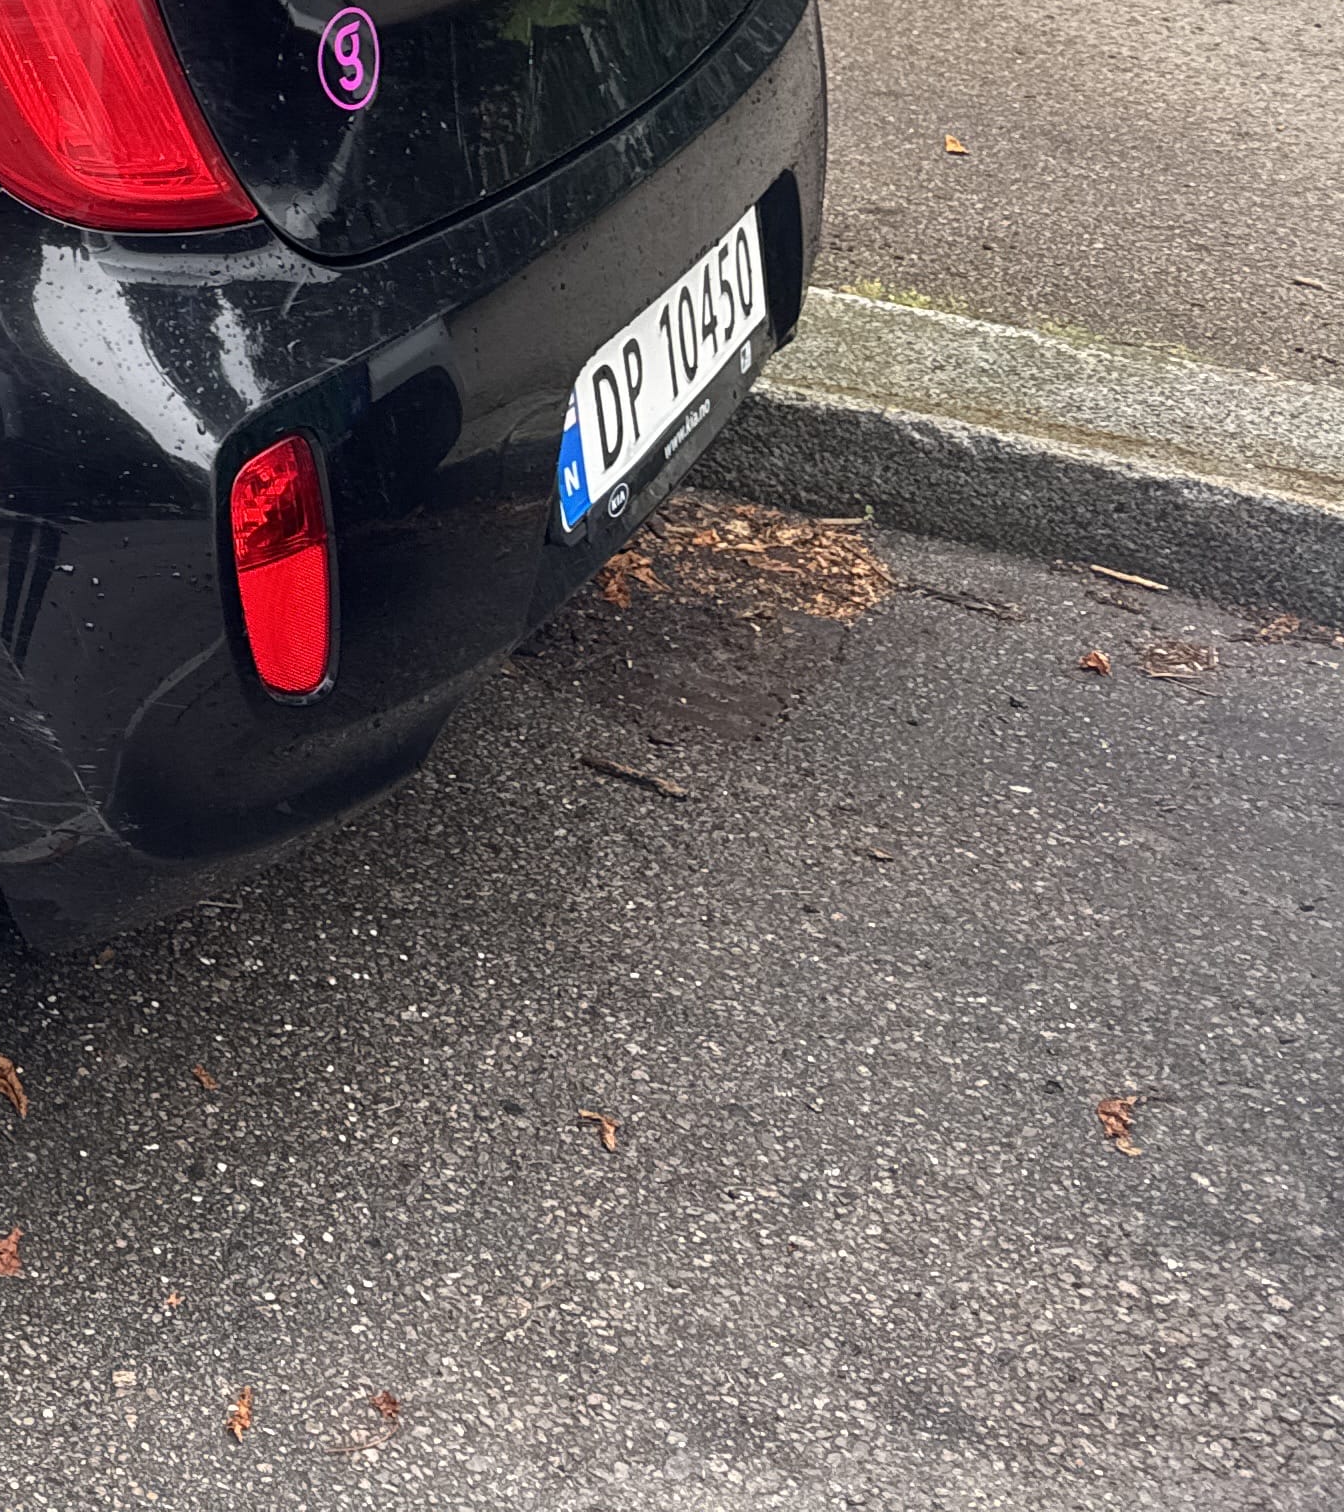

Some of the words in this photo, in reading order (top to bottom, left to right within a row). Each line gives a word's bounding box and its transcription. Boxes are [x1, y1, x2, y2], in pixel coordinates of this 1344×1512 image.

[563, 460, 580, 497] N
[592, 338, 643, 472] DP
[659, 226, 754, 401] 10450
[664, 398, 711, 460] www.kia.no
